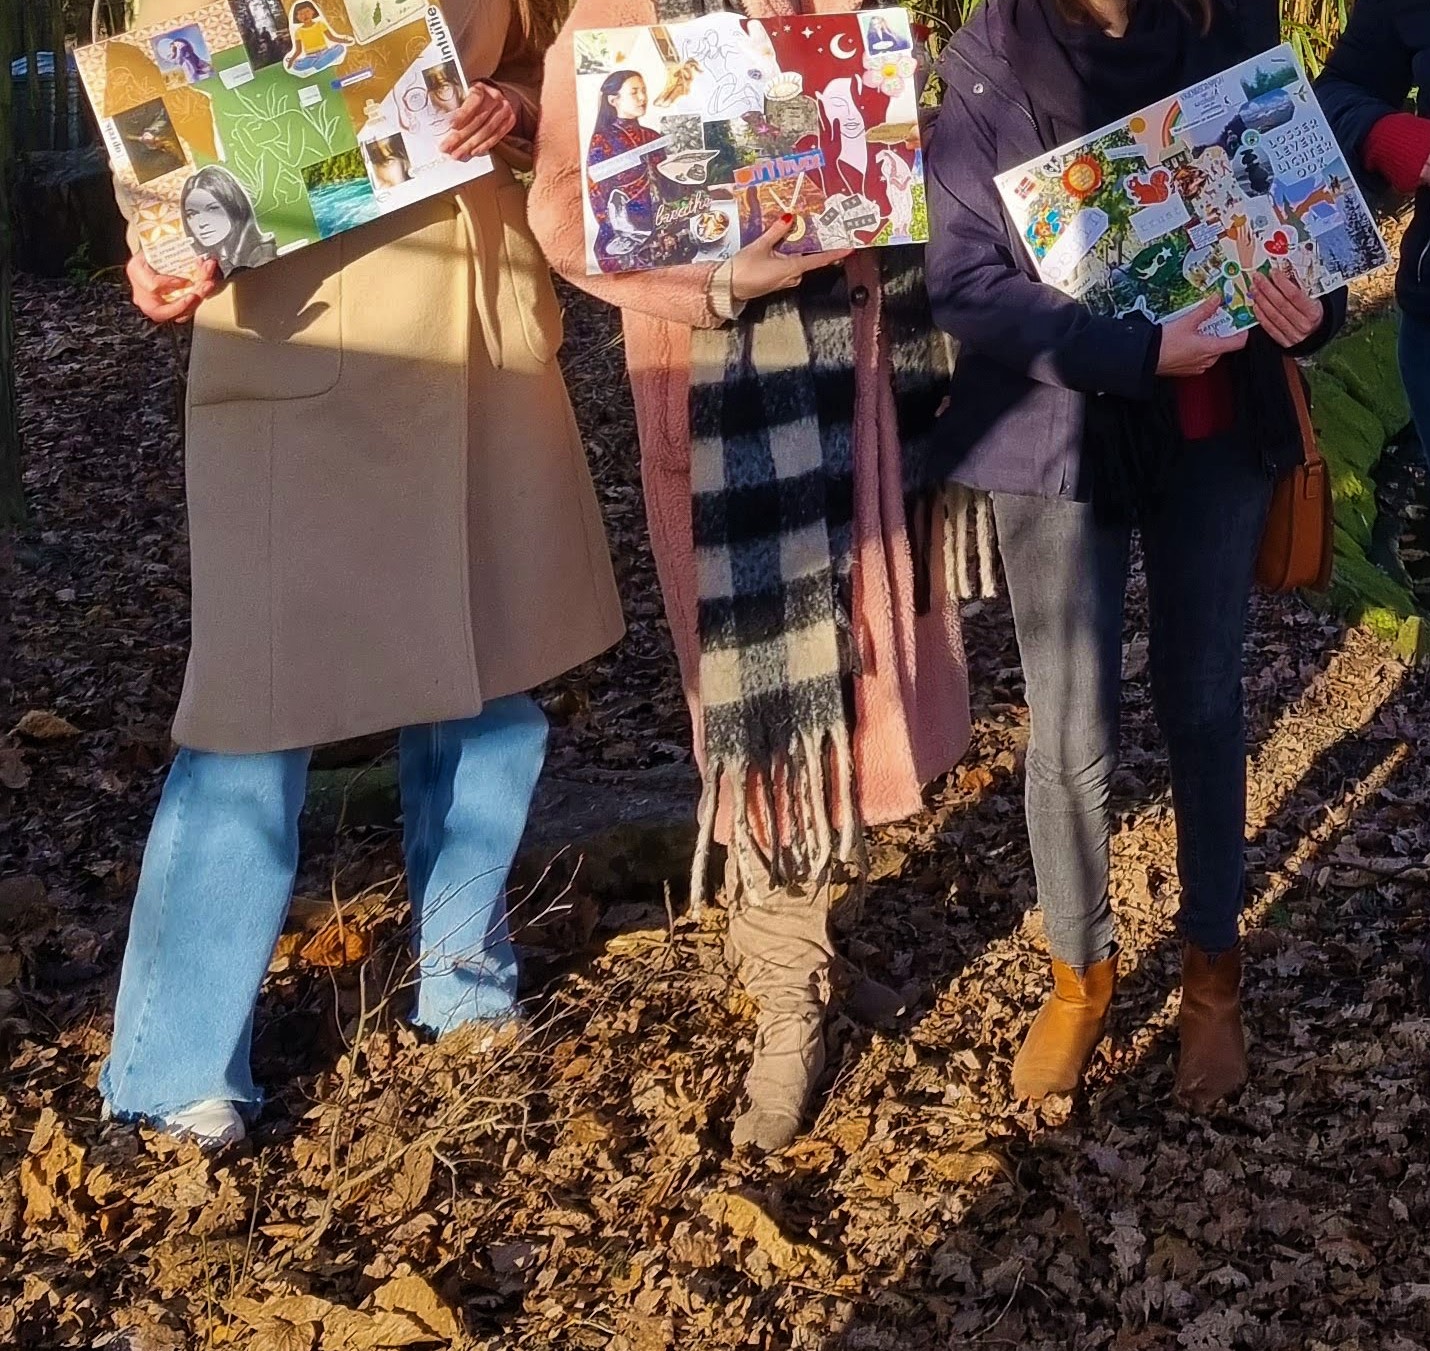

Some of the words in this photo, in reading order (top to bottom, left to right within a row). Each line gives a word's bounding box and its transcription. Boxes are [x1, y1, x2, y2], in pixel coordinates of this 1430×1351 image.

[1268, 119, 1320, 148] LOSSER
[1274, 132, 1325, 161] LEVEN,
[1276, 141, 1334, 175] LICHTER
[1295, 157, 1328, 178] OOK
[655, 191, 713, 226] breathe
